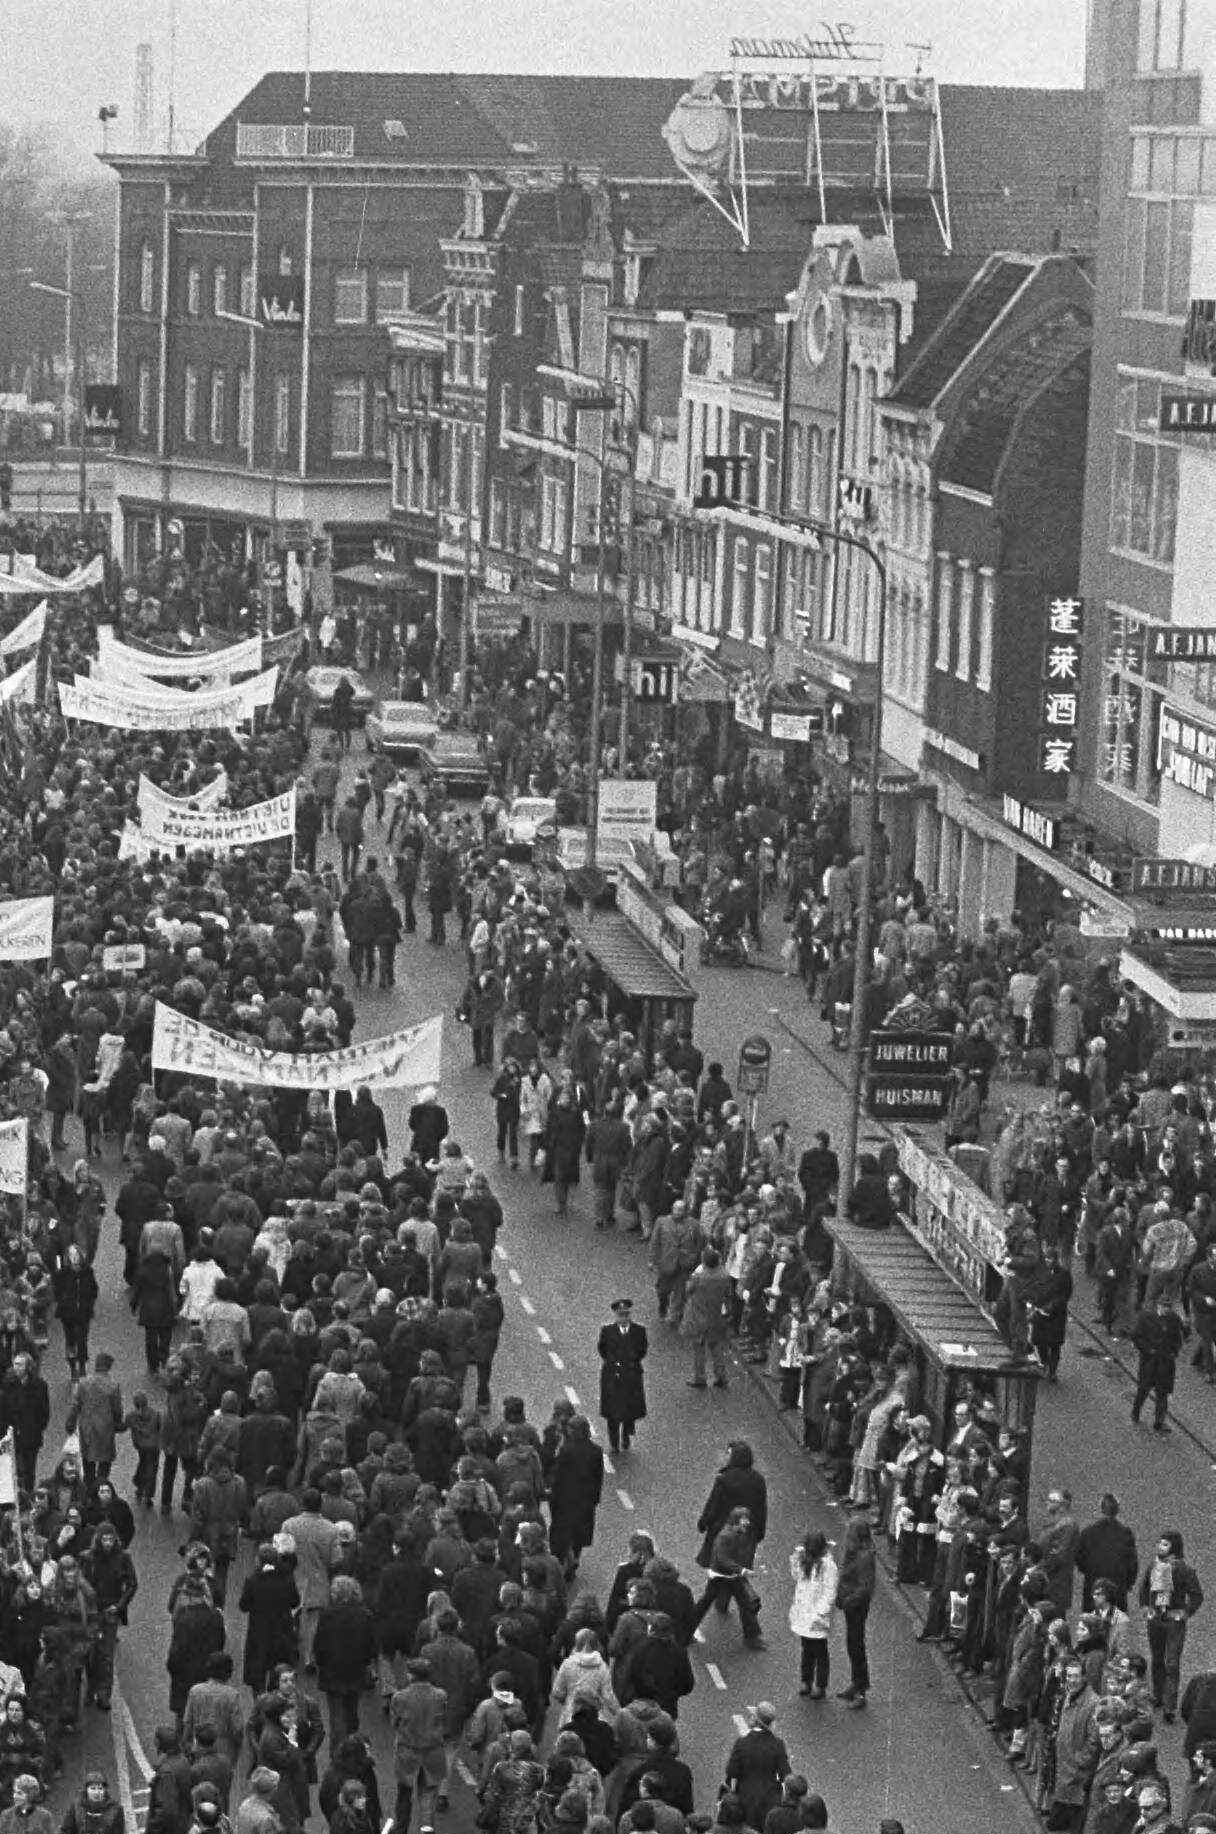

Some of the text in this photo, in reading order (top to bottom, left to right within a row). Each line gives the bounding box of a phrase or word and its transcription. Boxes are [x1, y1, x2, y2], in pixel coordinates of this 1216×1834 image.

[633, 659, 678, 705] hij
[875, 1043, 948, 1063] JUWELIER
[875, 1088, 943, 1107] HUISMAN
